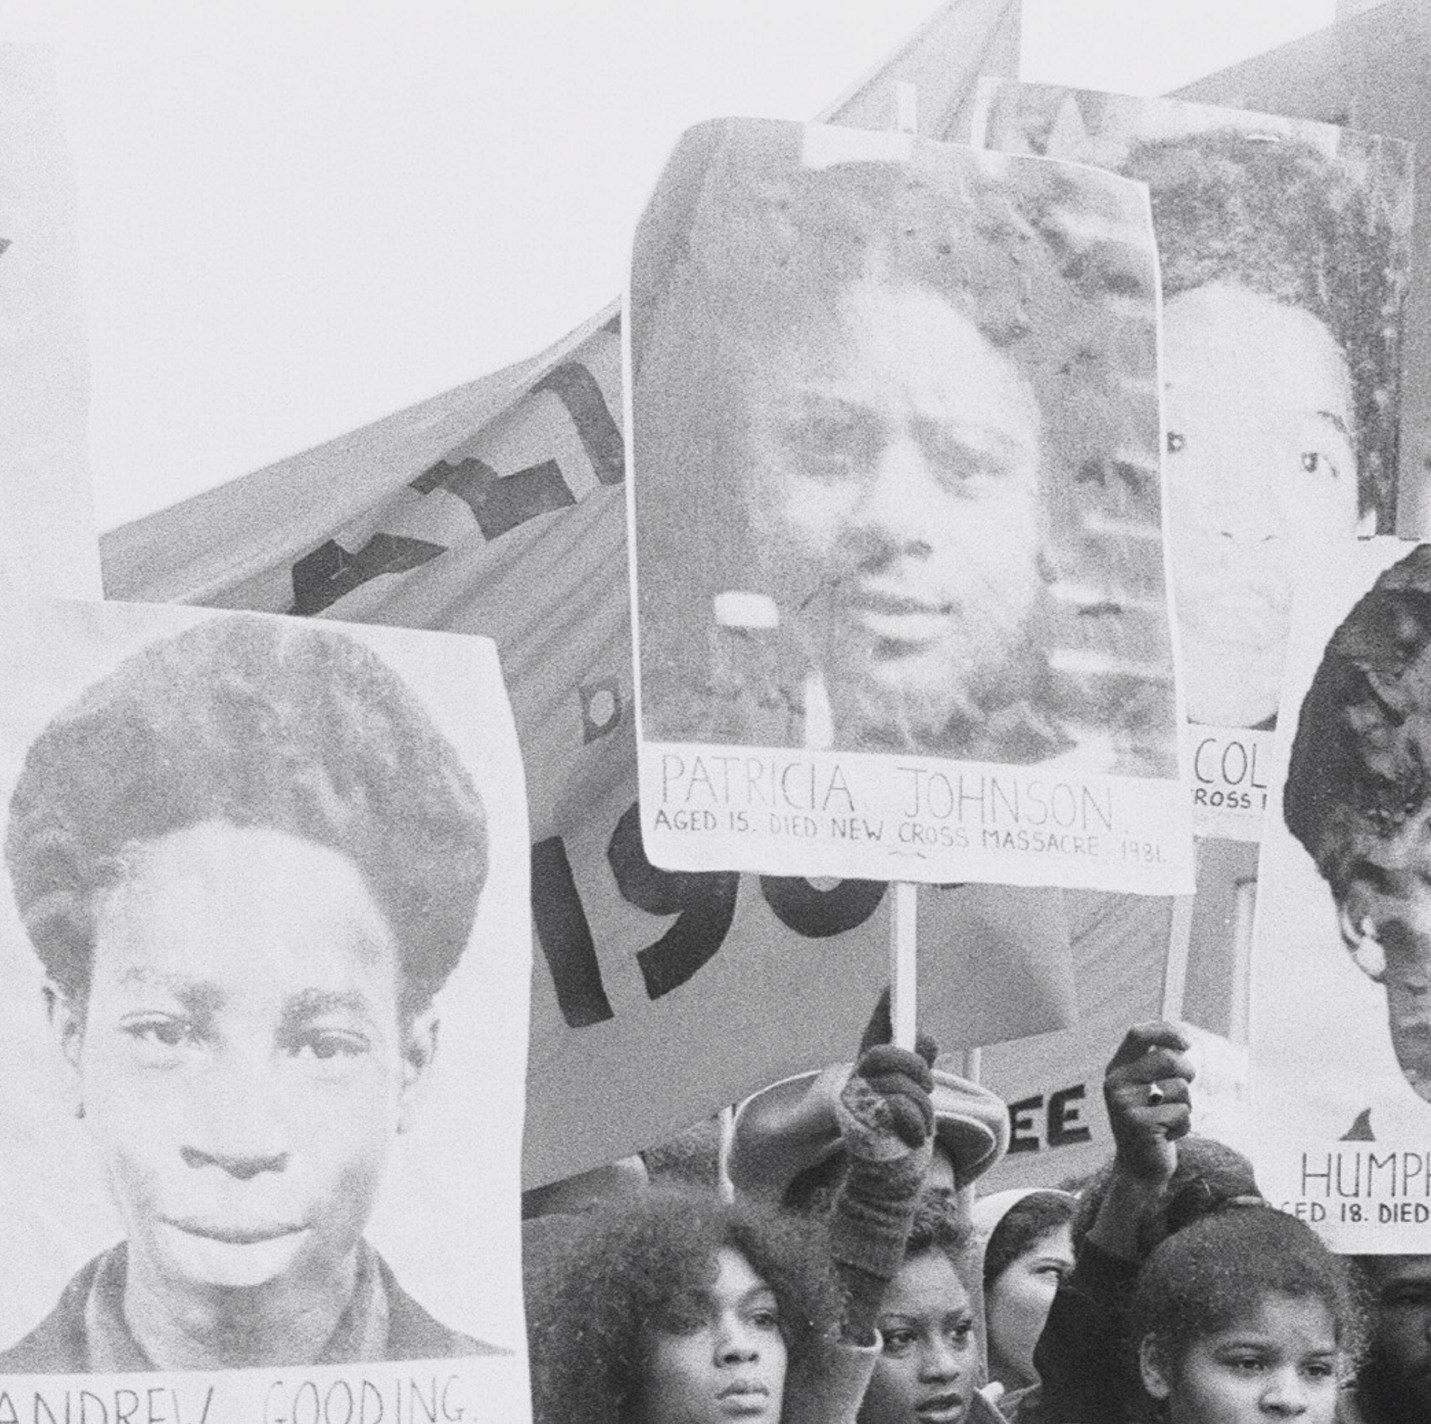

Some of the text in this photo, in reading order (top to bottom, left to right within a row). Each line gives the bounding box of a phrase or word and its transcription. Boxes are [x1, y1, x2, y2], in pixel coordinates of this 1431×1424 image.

[662, 754, 855, 812] PATRICIA
[1194, 737, 1268, 789] COL
[1190, 787, 1252, 810] ROSS
[654, 808, 718, 832] AGED
[769, 812, 818, 839] DIED
[831, 816, 884, 841] NEW
[898, 821, 970, 849] CROSS
[982, 828, 1099, 857] MASSACRE
[1378, 1202, 1430, 1224] DIED
